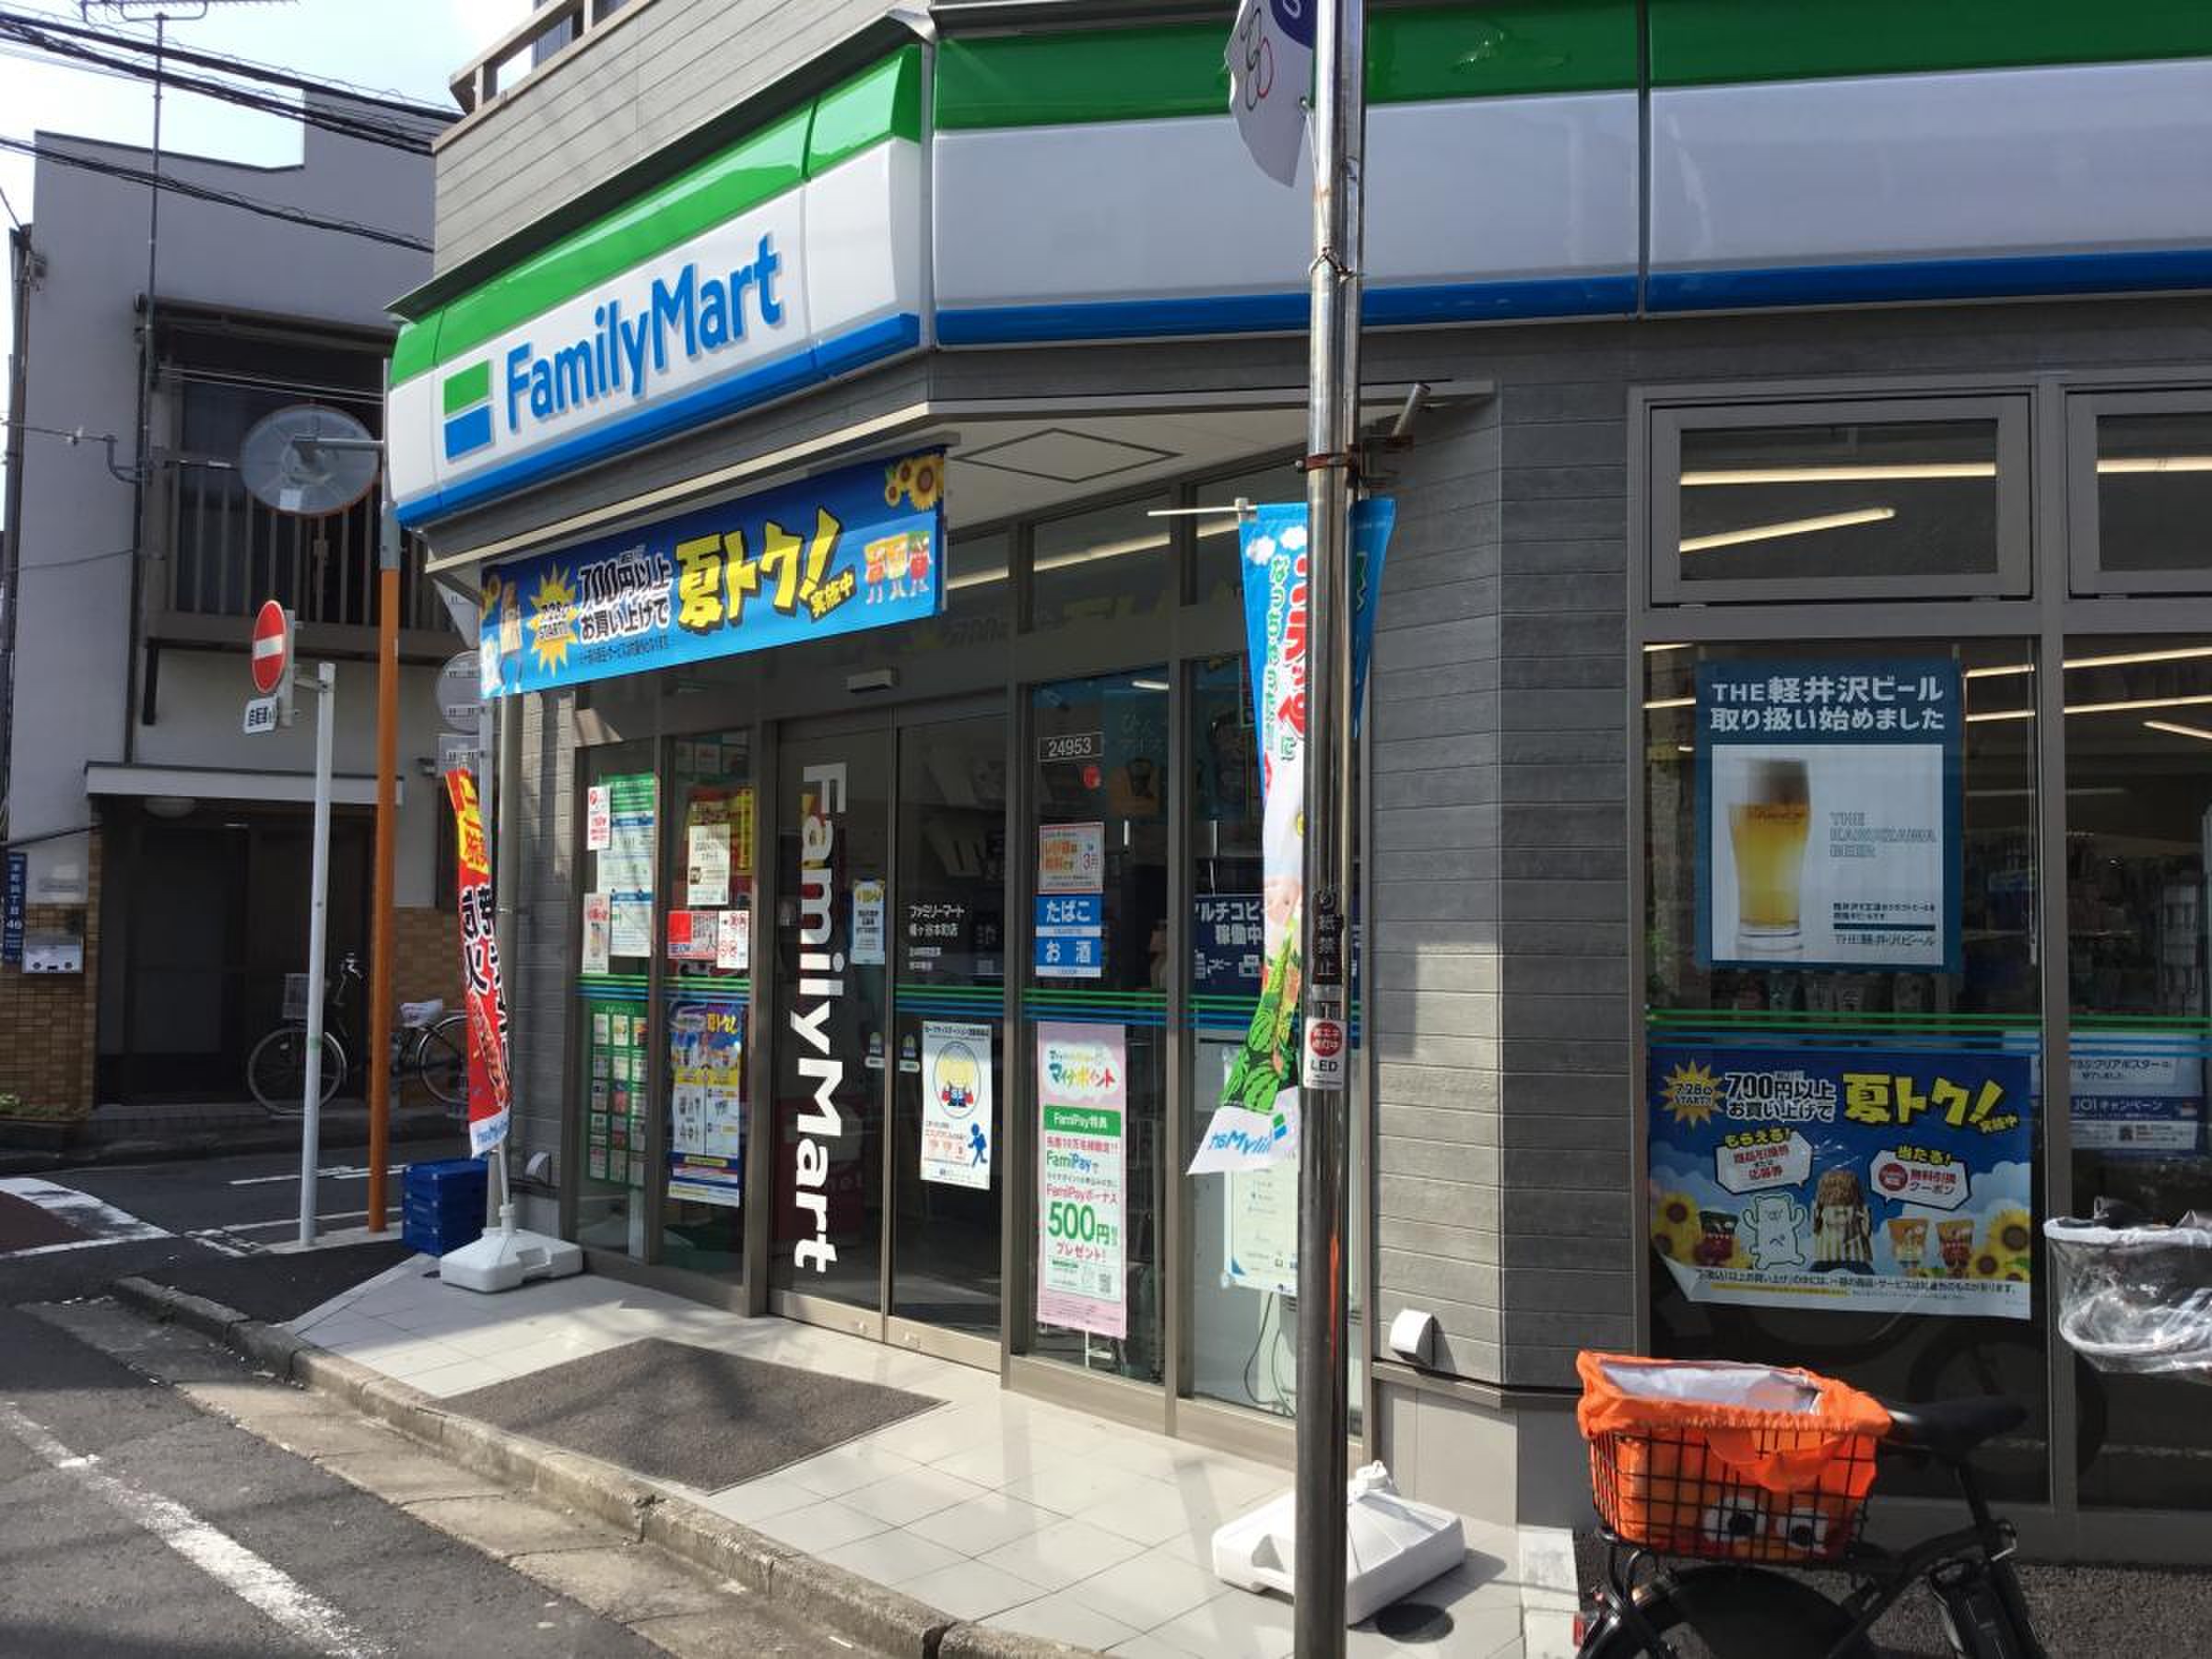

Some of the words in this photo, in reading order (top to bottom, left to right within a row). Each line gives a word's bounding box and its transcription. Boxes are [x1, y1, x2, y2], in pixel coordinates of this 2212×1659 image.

[507, 234, 782, 431] FamilyMart
[581, 597, 669, 639] お買い上げで
[1711, 675, 1945, 705] THE軽井沢ビール
[1710, 706, 1946, 732] 取り扱い始めました
[1048, 737, 1092, 758] 24953
[909, 904, 965, 918] ファミリーマート
[1046, 899, 1092, 923] たばこ
[1194, 901, 1264, 922] ルチコピ
[1045, 940, 1092, 964] お酒
[791, 763, 846, 1273] FamilyMart
[1311, 1059, 1338, 1072] LED
[1725, 1073, 1836, 1101] 700円以上
[1727, 1101, 1834, 1122] お買い上げで
[1047, 1201, 1111, 1246] 500円
